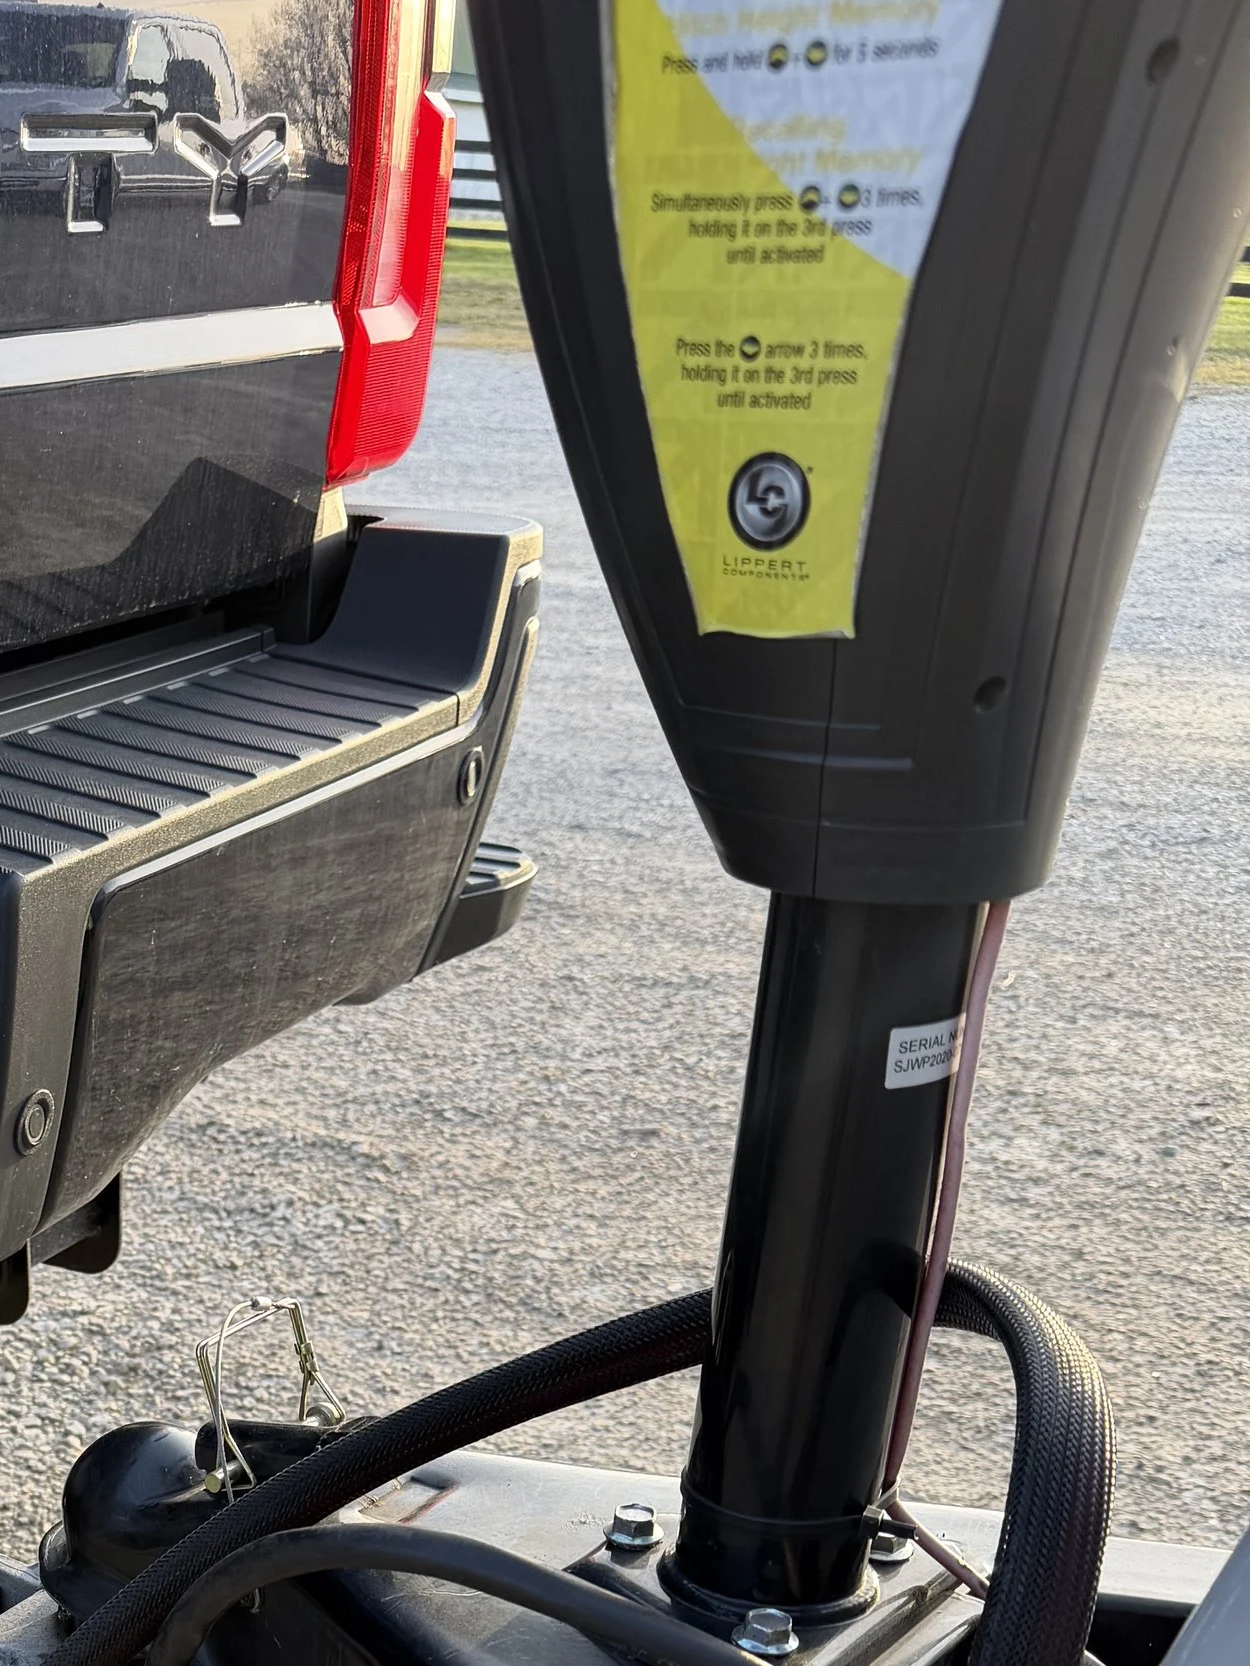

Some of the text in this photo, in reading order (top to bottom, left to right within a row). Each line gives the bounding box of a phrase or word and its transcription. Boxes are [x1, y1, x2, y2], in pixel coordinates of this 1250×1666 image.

[661, 53, 699, 75] Press
[703, 51, 727, 72] and
[871, 37, 940, 62] seconds
[651, 190, 749, 215] Simultaneously
[754, 193, 794, 215] press
[860, 188, 872, 208] 3
[688, 217, 873, 242] holding it on the 3rd press
[726, 245, 825, 265] until activated
[676, 338, 711, 358] Press
[714, 339, 735, 358] the
[764, 343, 805, 360] arrow
[809, 340, 819, 359] 3
[681, 364, 857, 388] holding it on the 3rd press
[717, 390, 812, 411] until activated
[723, 555, 807, 573] LIPPERT
[898, 1033, 946, 1054] SERIAL
